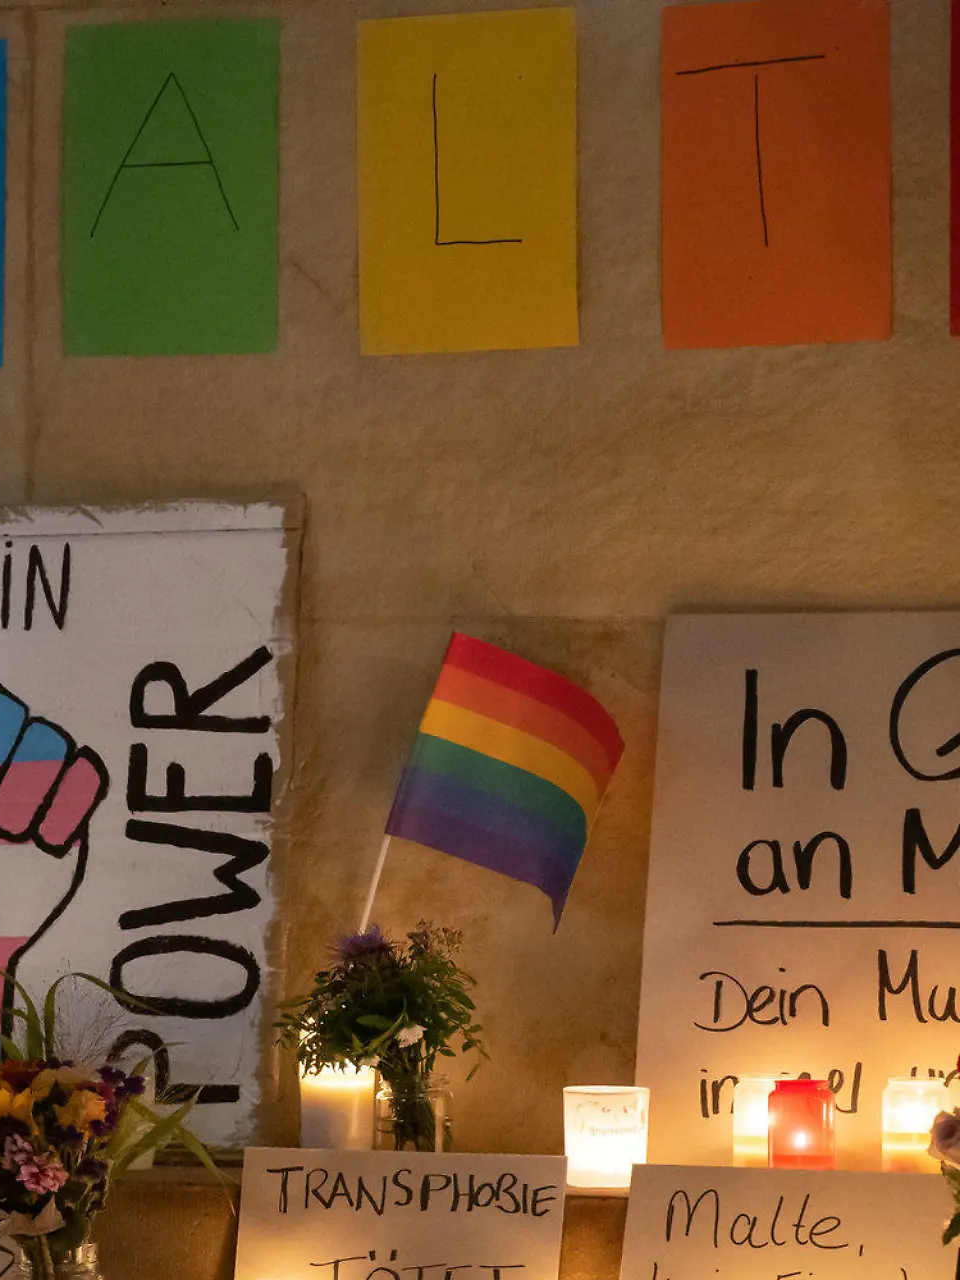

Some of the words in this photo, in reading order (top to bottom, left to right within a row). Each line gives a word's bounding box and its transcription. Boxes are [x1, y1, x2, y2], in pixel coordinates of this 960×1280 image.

[90, 72, 240, 239] A
[434, 73, 522, 246] L
[676, 54, 826, 248] T
[742, 668, 848, 791] In
[108, 645, 274, 1105] POWER
[736, 831, 852, 899] an
[693, 967, 830, 1033] Dein
[267, 1165, 558, 1218] TRANSPHOBIE
[666, 1188, 865, 1257] Malte,
